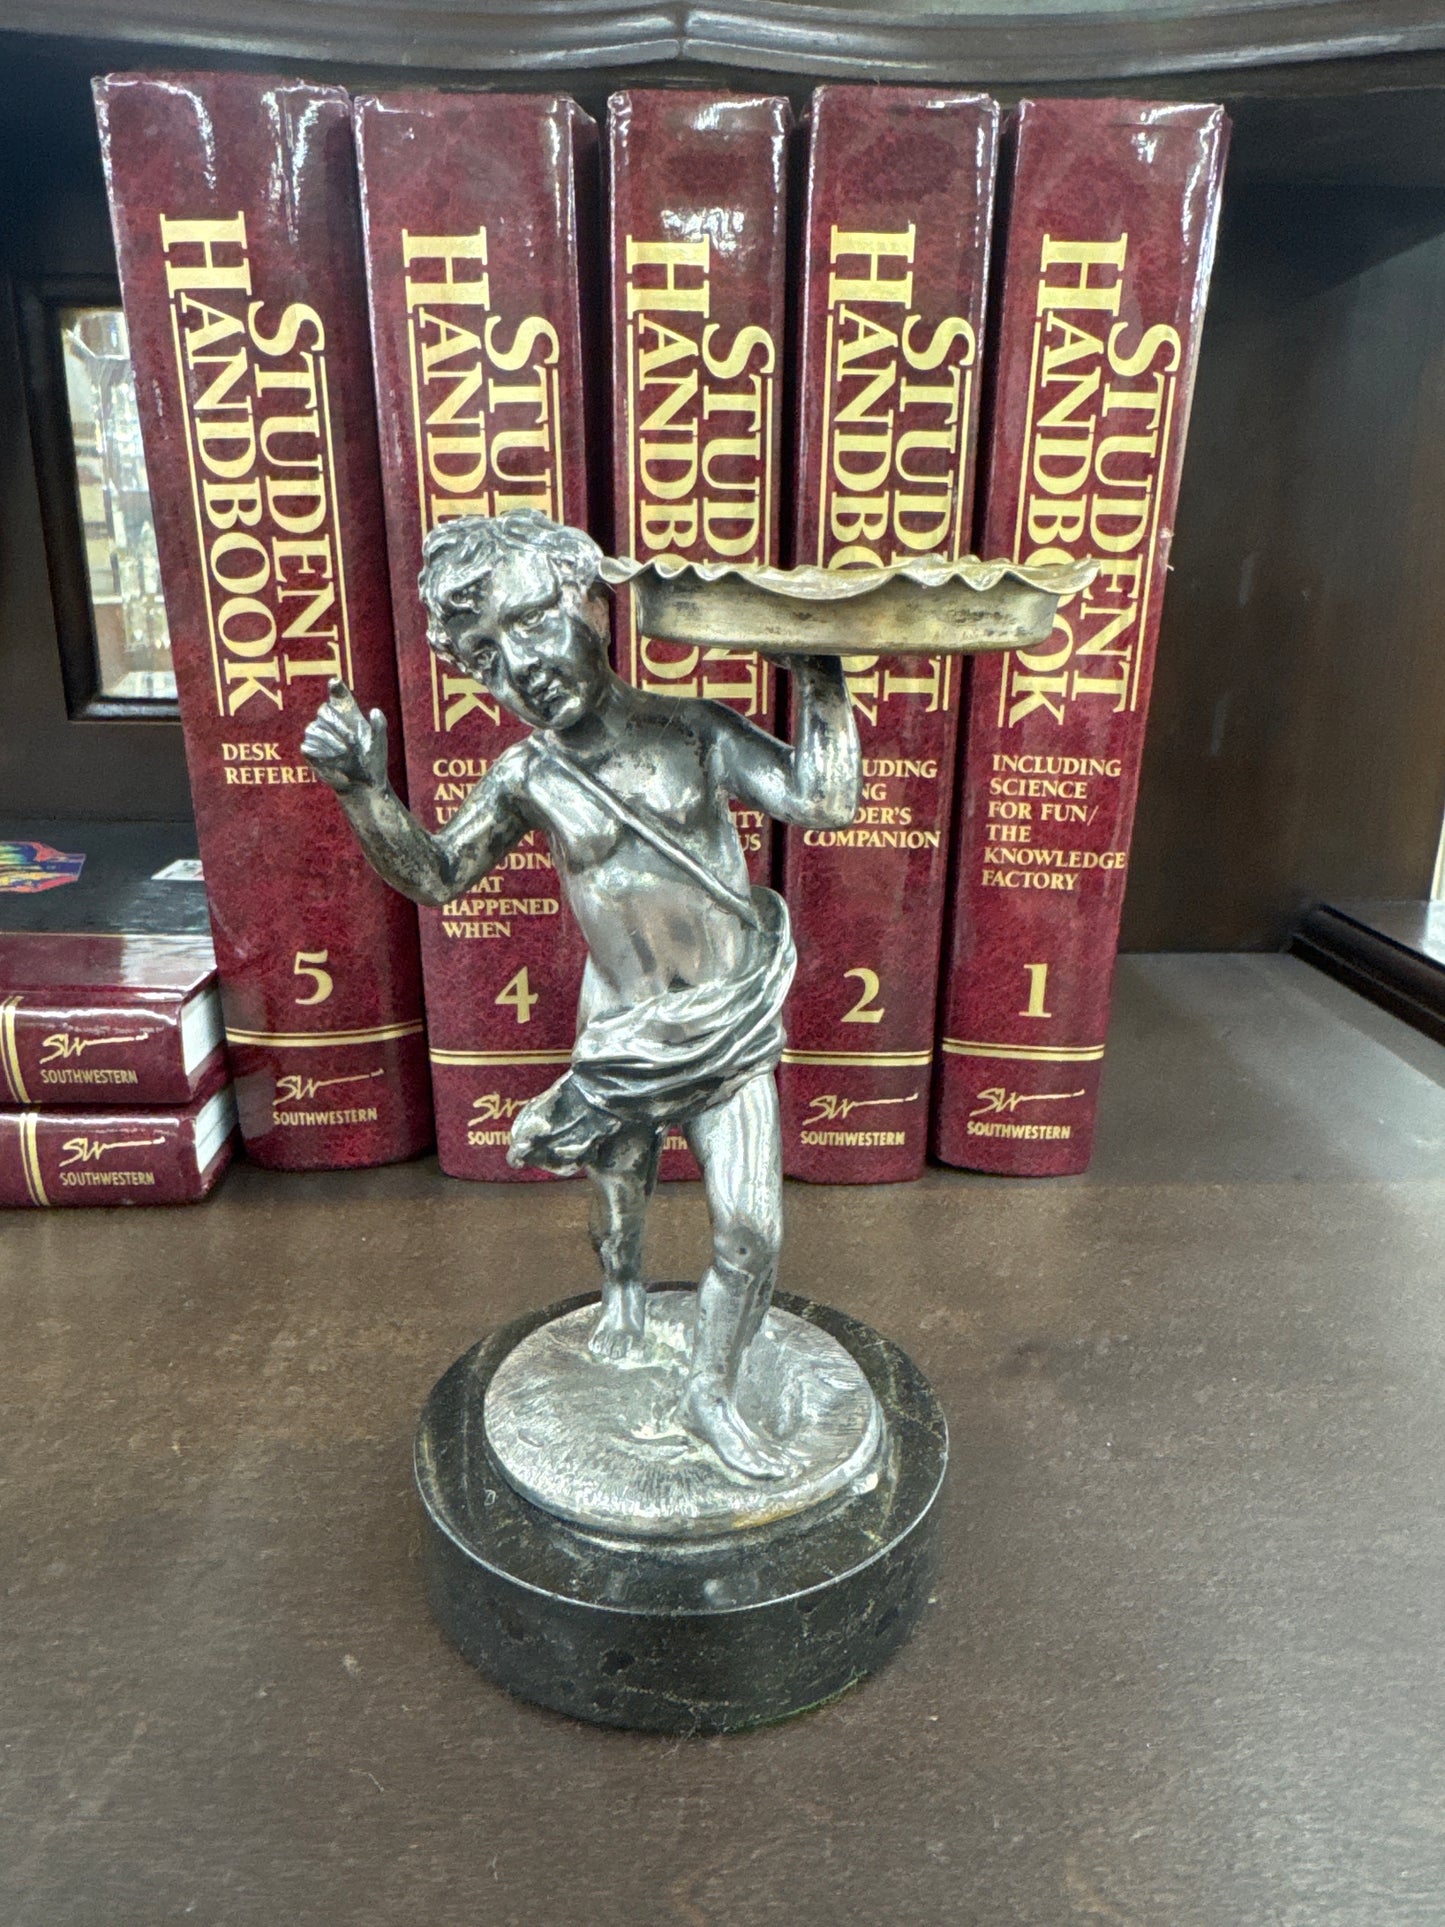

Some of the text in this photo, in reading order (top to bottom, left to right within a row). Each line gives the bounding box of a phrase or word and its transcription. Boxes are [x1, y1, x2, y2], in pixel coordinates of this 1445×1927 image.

[159, 210, 284, 716] HANDBOOK
[625, 233, 710, 698] HANDBO
[402, 226, 501, 732] HANDK
[828, 224, 916, 727] HANDB
[247, 300, 339, 685] STUDENT
[702, 322, 776, 717] STUDT
[884, 315, 976, 713] STUDT
[1071, 321, 1181, 713] STUDENT
[221, 742, 282, 761] DESK
[224, 765, 318, 785] REFERE
[863, 759, 938, 779] UDING
[992, 754, 1122, 778] INCLUDING
[989, 777, 1088, 799] SCIENCE
[853, 807, 912, 825] DER'S
[988, 800, 1099, 827] FOR FUN/
[803, 830, 941, 849] COMPANION
[985, 823, 1032, 842] THE
[984, 846, 1127, 869] KNOWLEDGE
[981, 869, 1078, 890] FACTORY
[442, 898, 559, 916] HAPPENED
[442, 921, 511, 938] WHEN
[294, 949, 334, 1006] 5
[494, 966, 539, 1024] 4
[840, 967, 885, 1023] 2
[1018, 963, 1052, 1018] 1
[40, 1068, 138, 1085] SOUTHWESTERN
[272, 1107, 378, 1125] SOUTHWESTERN
[800, 1130, 905, 1146] SOUTHWESTERN
[966, 1121, 1071, 1140] SOUTHWESTERN
[59, 1171, 155, 1186] SOUTHWESTERN
